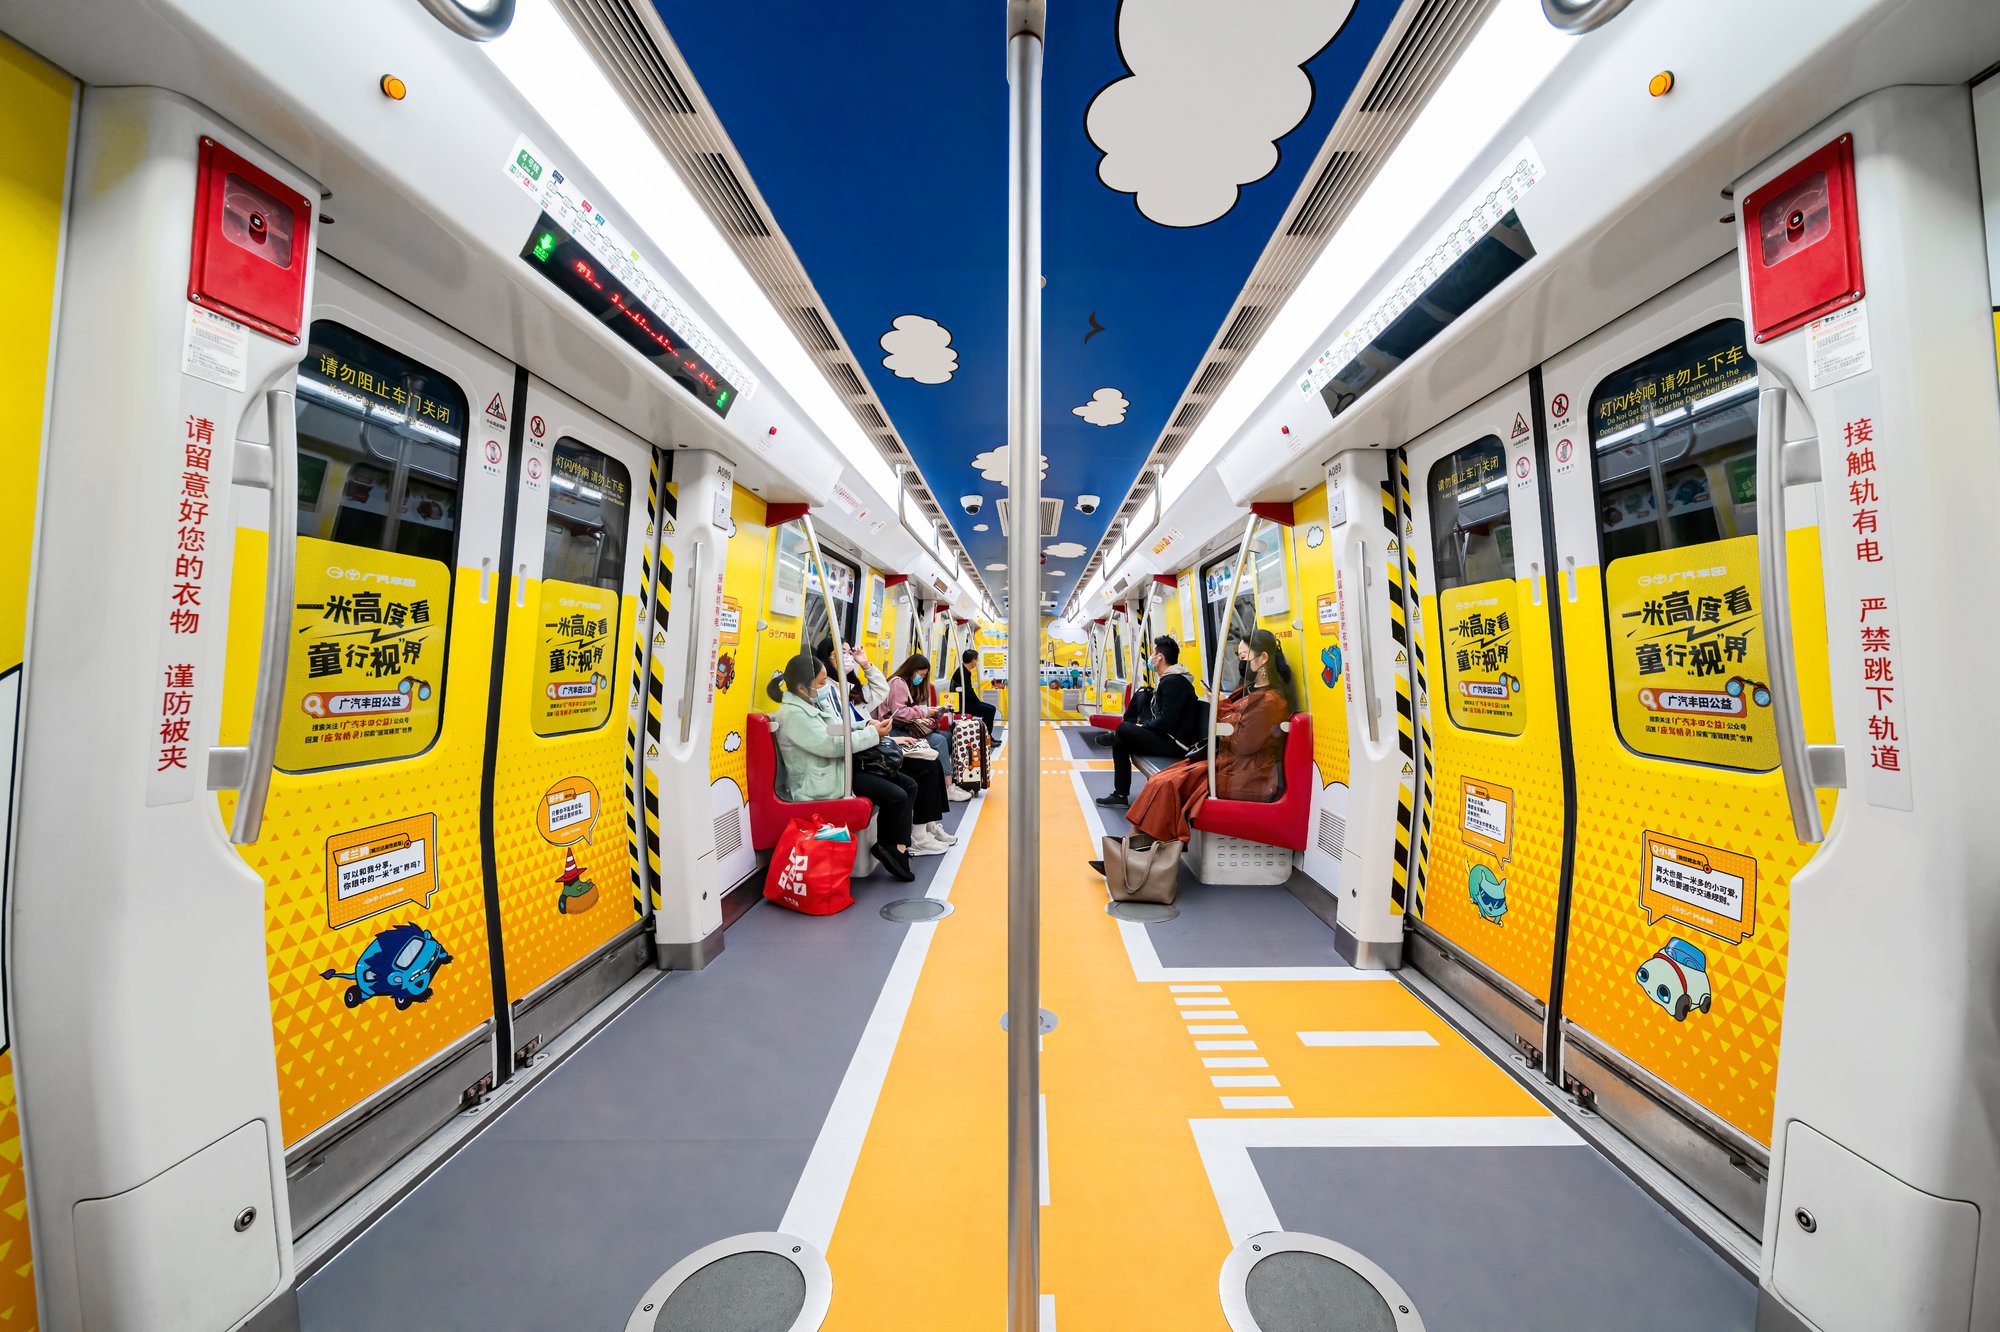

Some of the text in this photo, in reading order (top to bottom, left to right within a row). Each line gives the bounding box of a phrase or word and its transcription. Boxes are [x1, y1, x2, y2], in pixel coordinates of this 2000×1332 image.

[320, 354, 450, 424] 请勿阻止车门关闭
[329, 384, 352, 400] Keep
[1600, 345, 1744, 419] 灯闪/铃响 请勿上下车
[1658, 395, 1670, 406] Off
[1670, 392, 1682, 402] the
[1682, 384, 1701, 398] Train
[1702, 375, 1724, 390] When
[1726, 368, 1740, 380] the
[1672, 400, 1684, 410] the
[1328, 462, 1342, 478] A089
[1438, 456, 1498, 492] 请勿阻止车门关闭
[169, 414, 215, 635] 请留意好您的衣物
[296, 591, 430, 628] 一米高度看
[1622, 585, 1753, 626] 一米高度看
[1843, 417, 1900, 772] 接触轨有电 严禁跳下轨道
[546, 614, 608, 638] 一米高度看
[1448, 612, 1510, 638] 一米高度看
[157, 663, 195, 772] 谨防被夹
[339, 696, 402, 710] 广汽丰田公益
[1668, 695, 1733, 710] 广汽丰田公益
